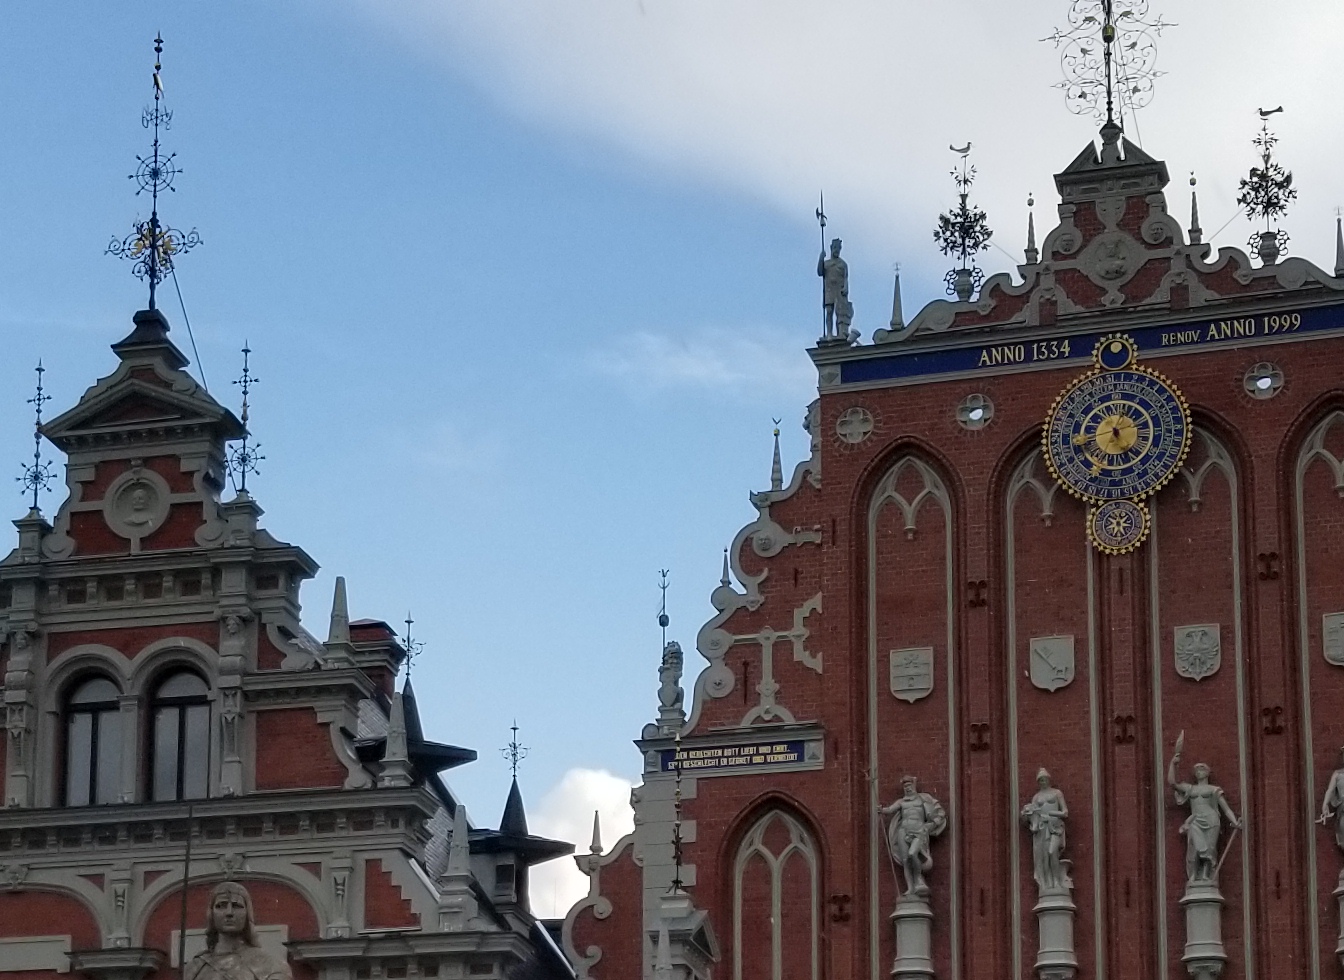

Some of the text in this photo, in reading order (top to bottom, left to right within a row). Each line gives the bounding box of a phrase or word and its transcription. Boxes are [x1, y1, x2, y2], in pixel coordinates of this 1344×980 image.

[978, 313, 1301, 367] ANNO 1334 RENOV. ANNO 1999
